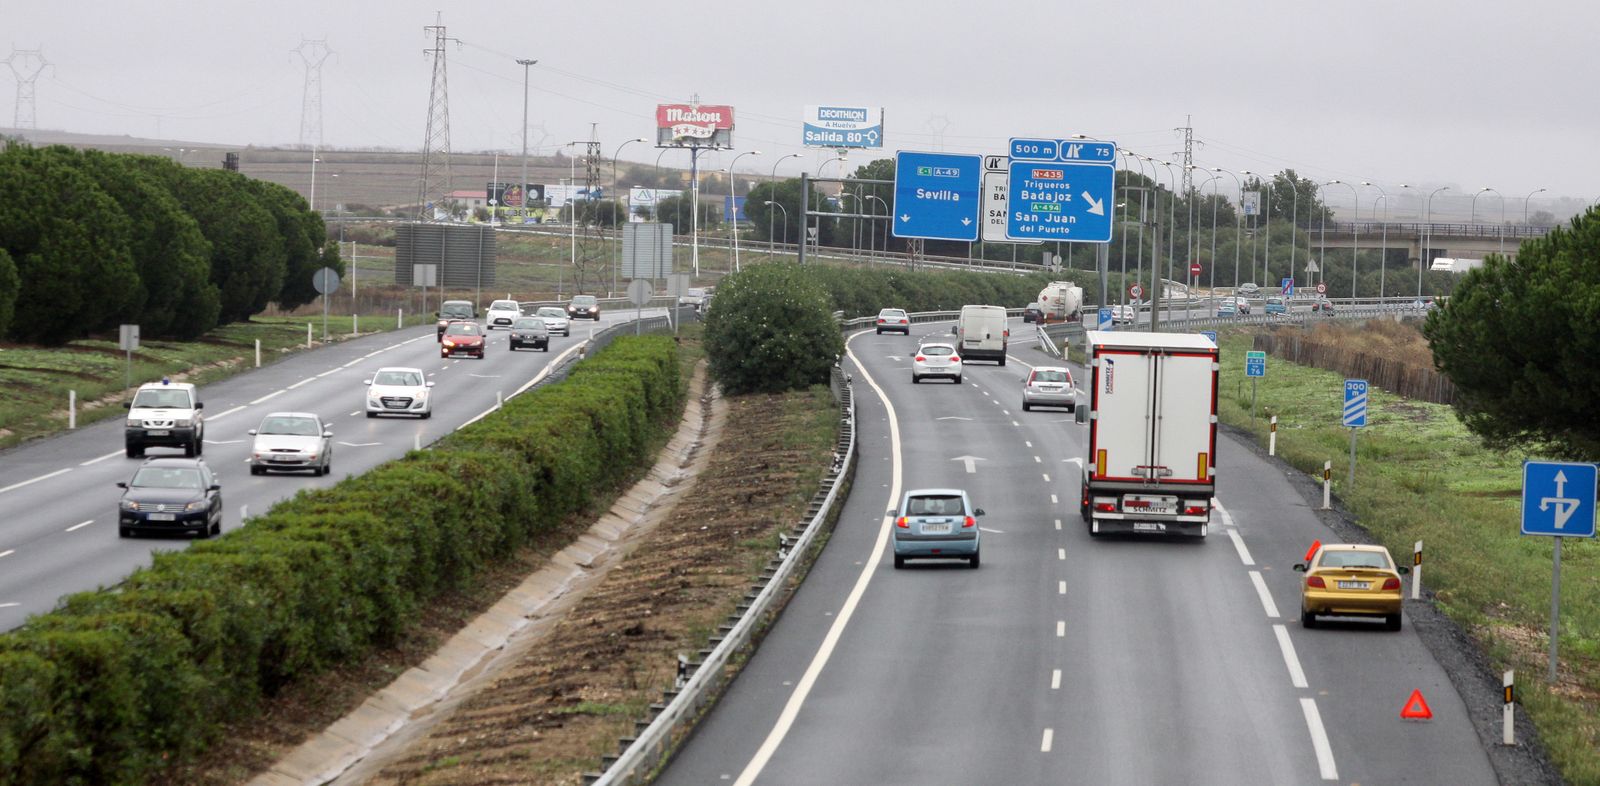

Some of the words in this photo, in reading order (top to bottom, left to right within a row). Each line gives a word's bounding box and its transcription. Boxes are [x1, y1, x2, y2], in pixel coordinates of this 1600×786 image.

[666, 108, 722, 122] Mahou
[820, 110, 865, 119] DECATHLON
[805, 131, 844, 142] Salida
[846, 132, 862, 143] 80
[1015, 145, 1039, 154] 500
[1095, 148, 1110, 157] 75
[1024, 180, 1070, 190] Trigueros
[916, 188, 960, 201] Sevilla
[1021, 190, 1072, 203] Badajoz
[1015, 211, 1039, 222] San
[1044, 213, 1076, 224] Juan
[1019, 224, 1035, 233] del
[1038, 225, 1070, 234] Puerto
[1347, 383, 1365, 391] 300
